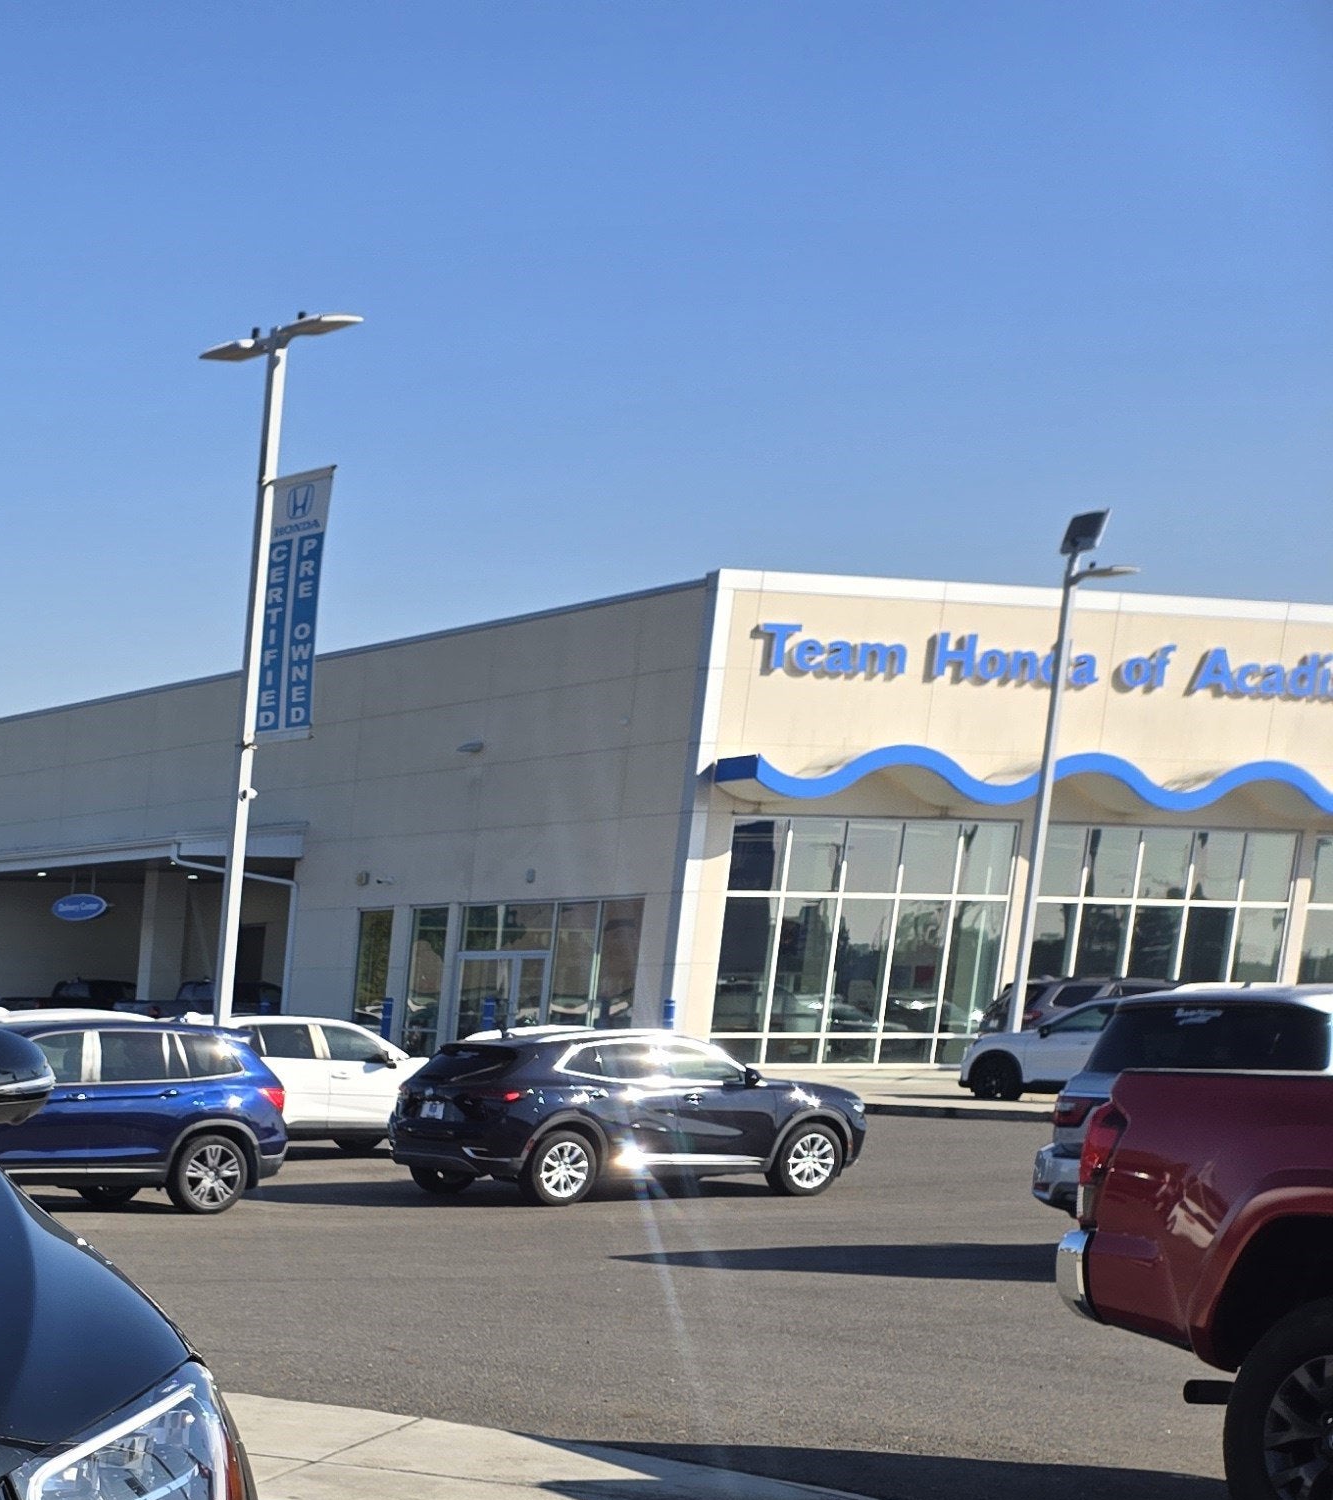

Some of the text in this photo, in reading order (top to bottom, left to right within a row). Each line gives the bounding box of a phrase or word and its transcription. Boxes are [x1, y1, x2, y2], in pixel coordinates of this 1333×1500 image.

[259, 544, 289, 728] CERTIFIED
[290, 538, 318, 724] PRE OWNED
[759, 622, 908, 674] Team
[1122, 643, 1178, 689] of
[1193, 646, 1333, 696] Acadi
